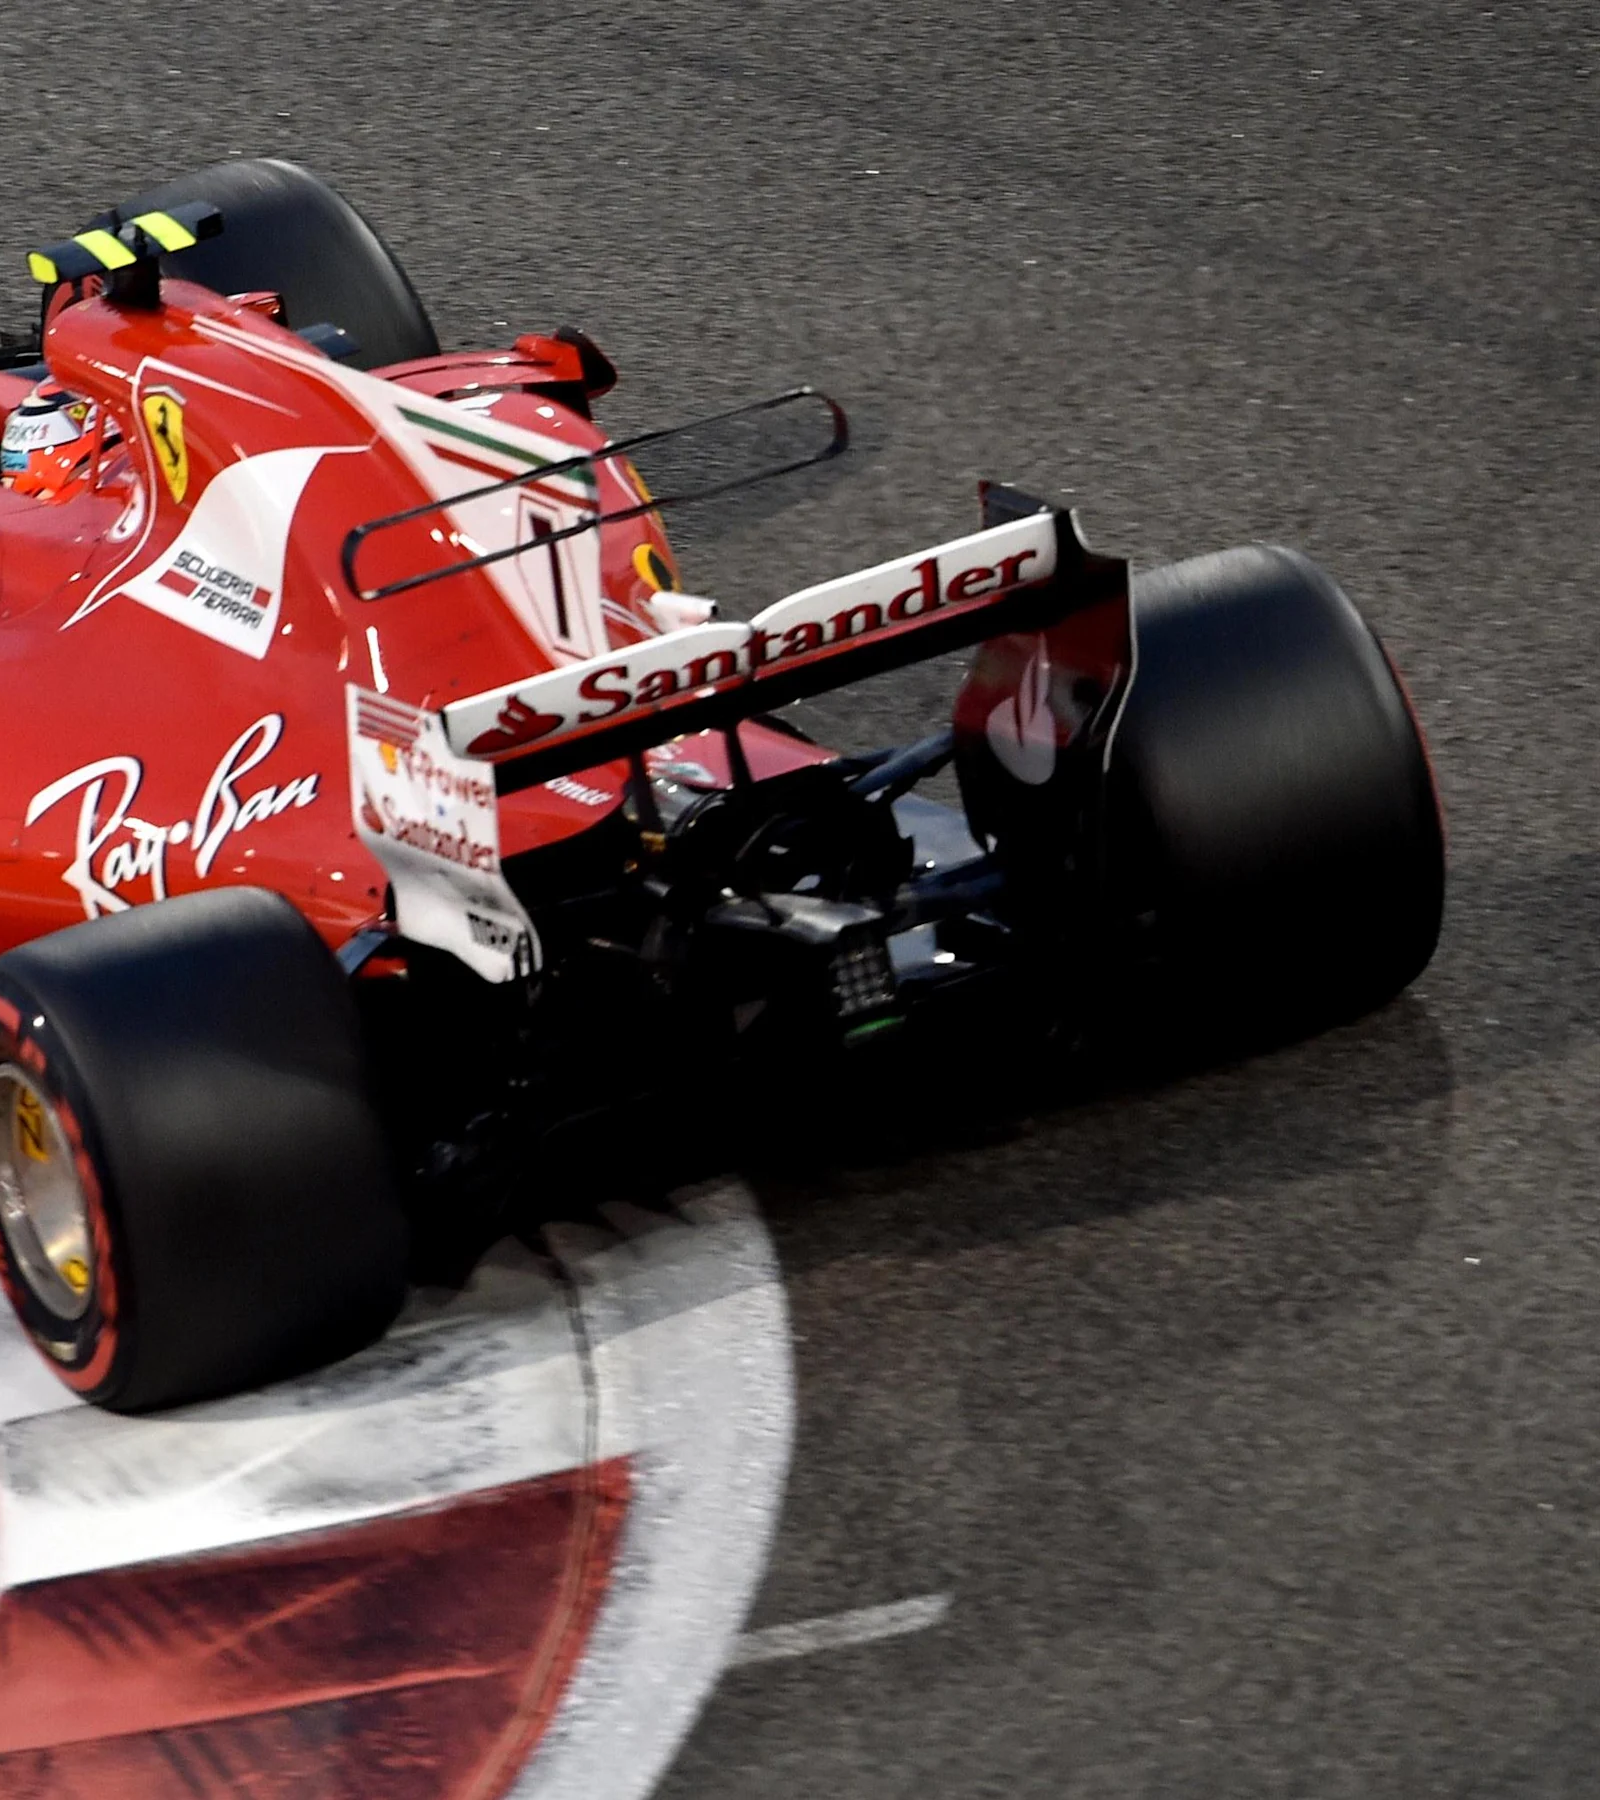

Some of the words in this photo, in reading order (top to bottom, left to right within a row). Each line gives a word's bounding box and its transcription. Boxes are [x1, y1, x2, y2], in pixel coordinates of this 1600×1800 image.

[173, 549, 254, 599] SCUDERIA
[191, 585, 264, 629] FERRARI
[578, 548, 1037, 725] Santander
